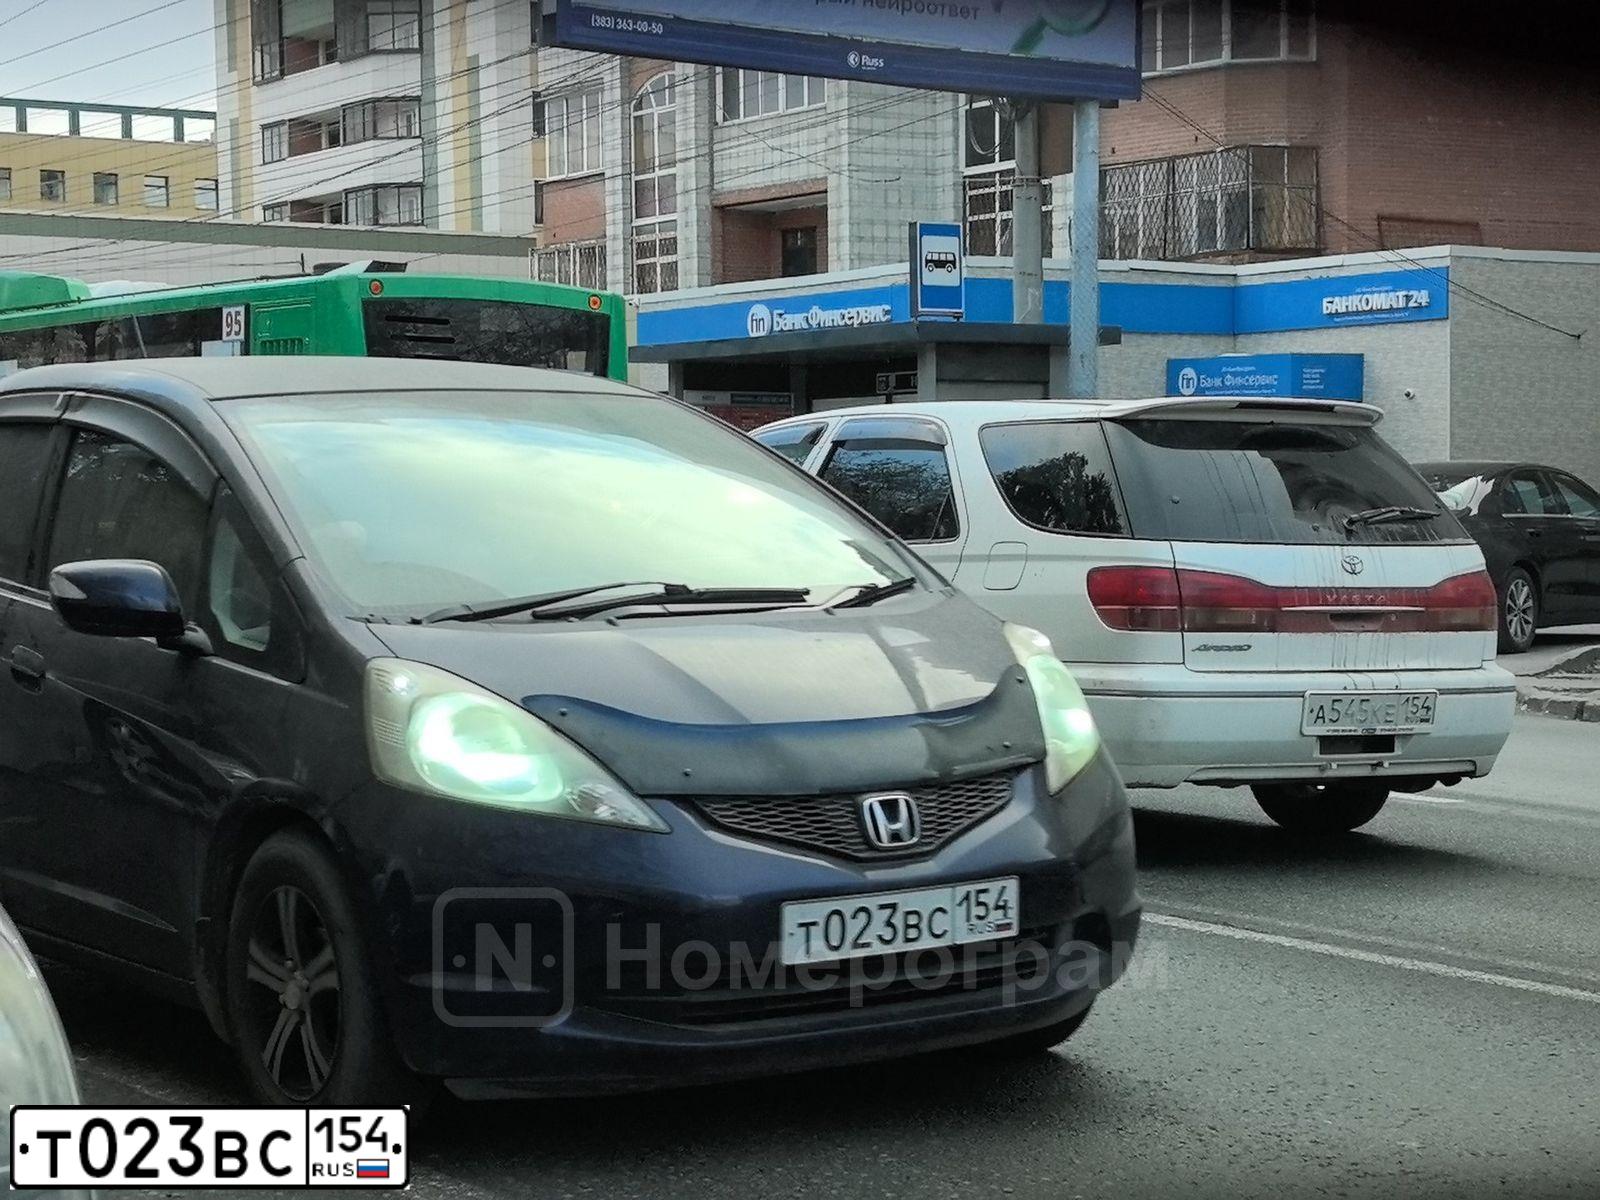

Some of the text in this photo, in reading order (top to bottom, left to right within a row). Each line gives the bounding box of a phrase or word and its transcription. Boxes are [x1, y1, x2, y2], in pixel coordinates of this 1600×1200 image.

[861, 54, 885, 68] Russ
[225, 310, 242, 337] 95
[1199, 374, 1223, 388] Банк
[1401, 695, 1433, 716] 154
[956, 885, 1014, 924] 154
